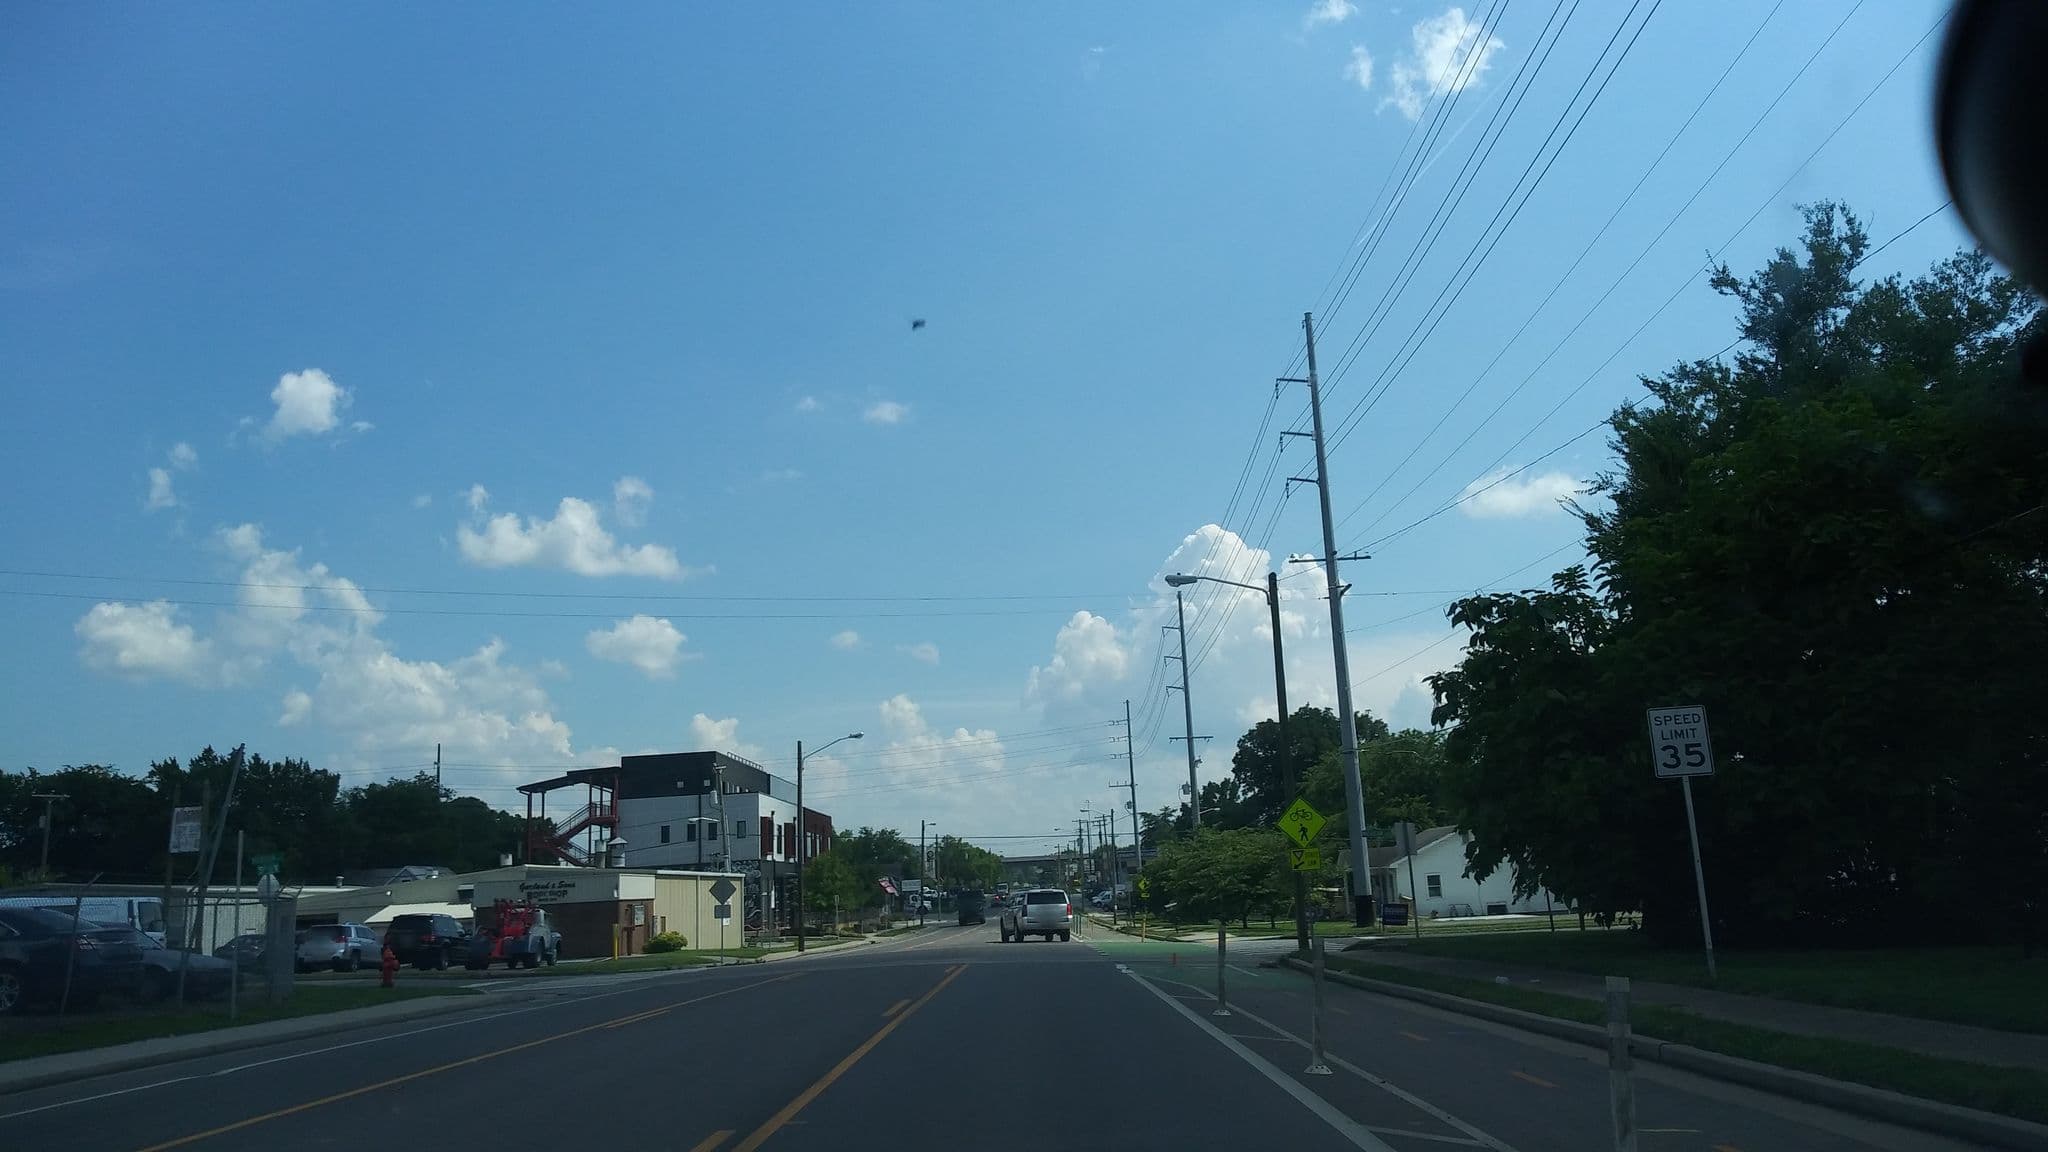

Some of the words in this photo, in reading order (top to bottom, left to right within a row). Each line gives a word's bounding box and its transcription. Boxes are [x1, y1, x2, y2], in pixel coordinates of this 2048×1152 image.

[1654, 713, 1701, 726] SPEED
[1661, 728, 1697, 740] LIMIT
[1660, 743, 1705, 769] 35
